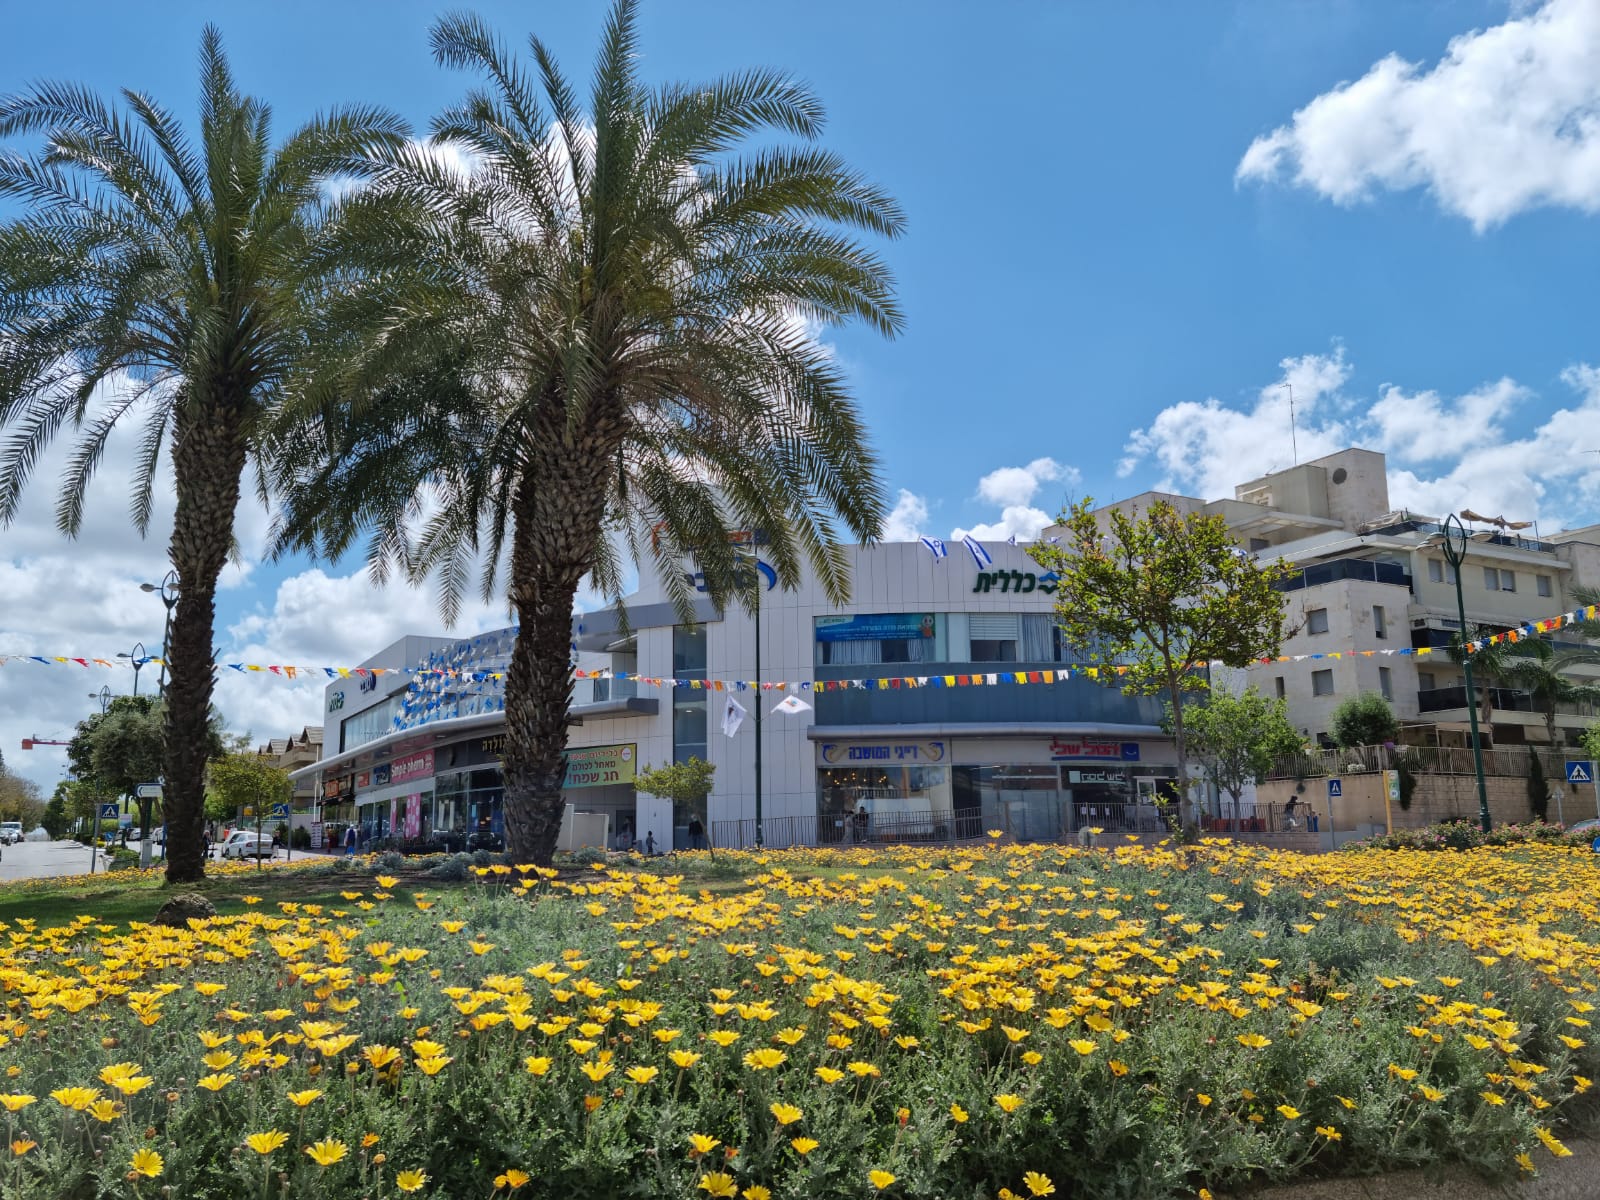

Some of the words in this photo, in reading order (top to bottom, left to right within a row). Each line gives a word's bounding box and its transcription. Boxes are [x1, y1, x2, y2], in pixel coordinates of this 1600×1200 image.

[973, 569, 1036, 593] כללית
[848, 745, 890, 760] המושבה
[572, 762, 593, 771] לכולם
[594, 760, 616, 769] מאחל
[568, 772, 600, 784] שמח!
[603, 771, 619, 782] חג
